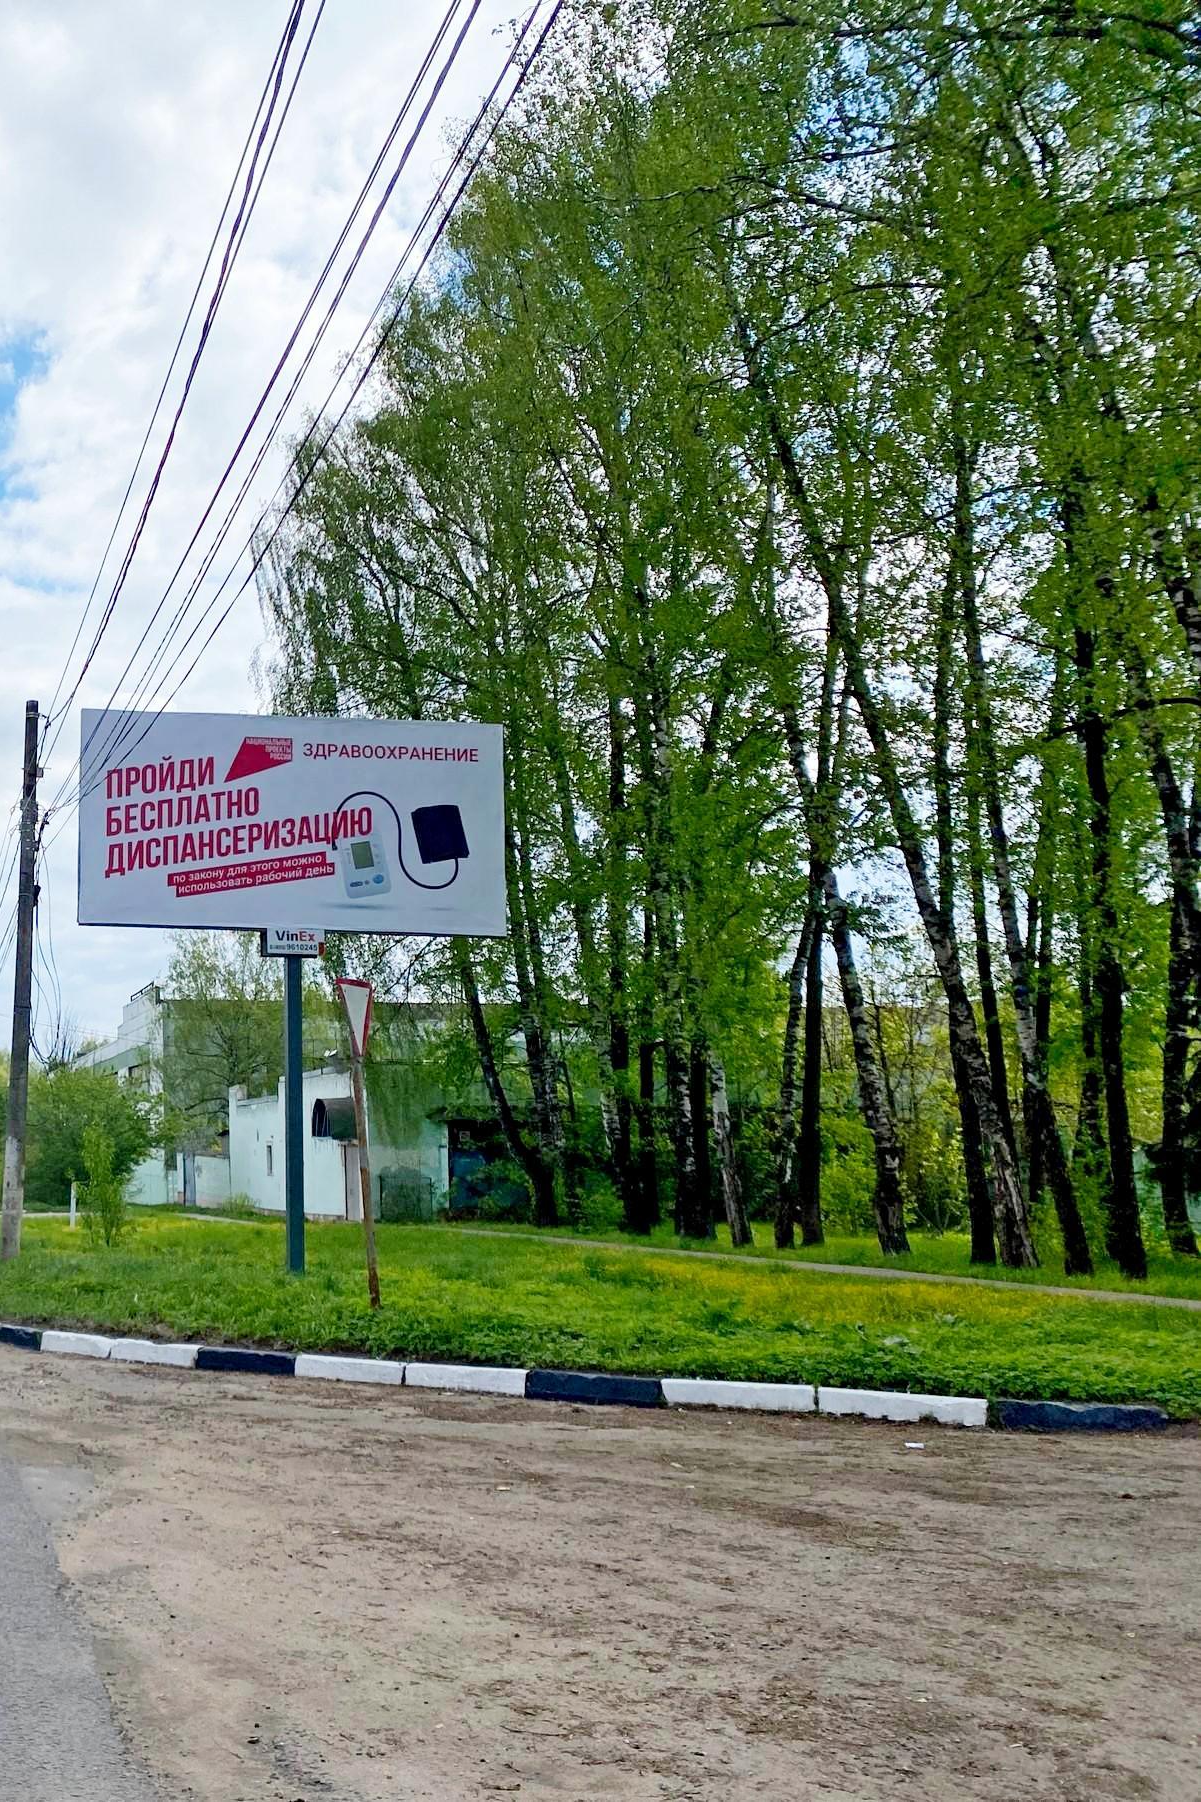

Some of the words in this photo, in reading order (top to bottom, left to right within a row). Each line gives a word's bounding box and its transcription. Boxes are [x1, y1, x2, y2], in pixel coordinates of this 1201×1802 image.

[302, 742, 479, 763] ЗДРАВООХРАНЕНИЕ
[106, 756, 215, 800] ПРОЙДИ
[106, 787, 260, 837] БЕСПЛАТНО
[104, 807, 373, 878] ДИСПАНСЕРИЗАЦИЮ
[173, 875, 186, 884] по
[189, 869, 224, 881] закону
[227, 866, 247, 877] для
[250, 861, 280, 873] этого
[283, 854, 322, 867] можно
[178, 877, 253, 894] использовать
[255, 867, 302, 885] рабочий
[305, 864, 334, 878] день
[275, 930, 315, 941] VinEx
